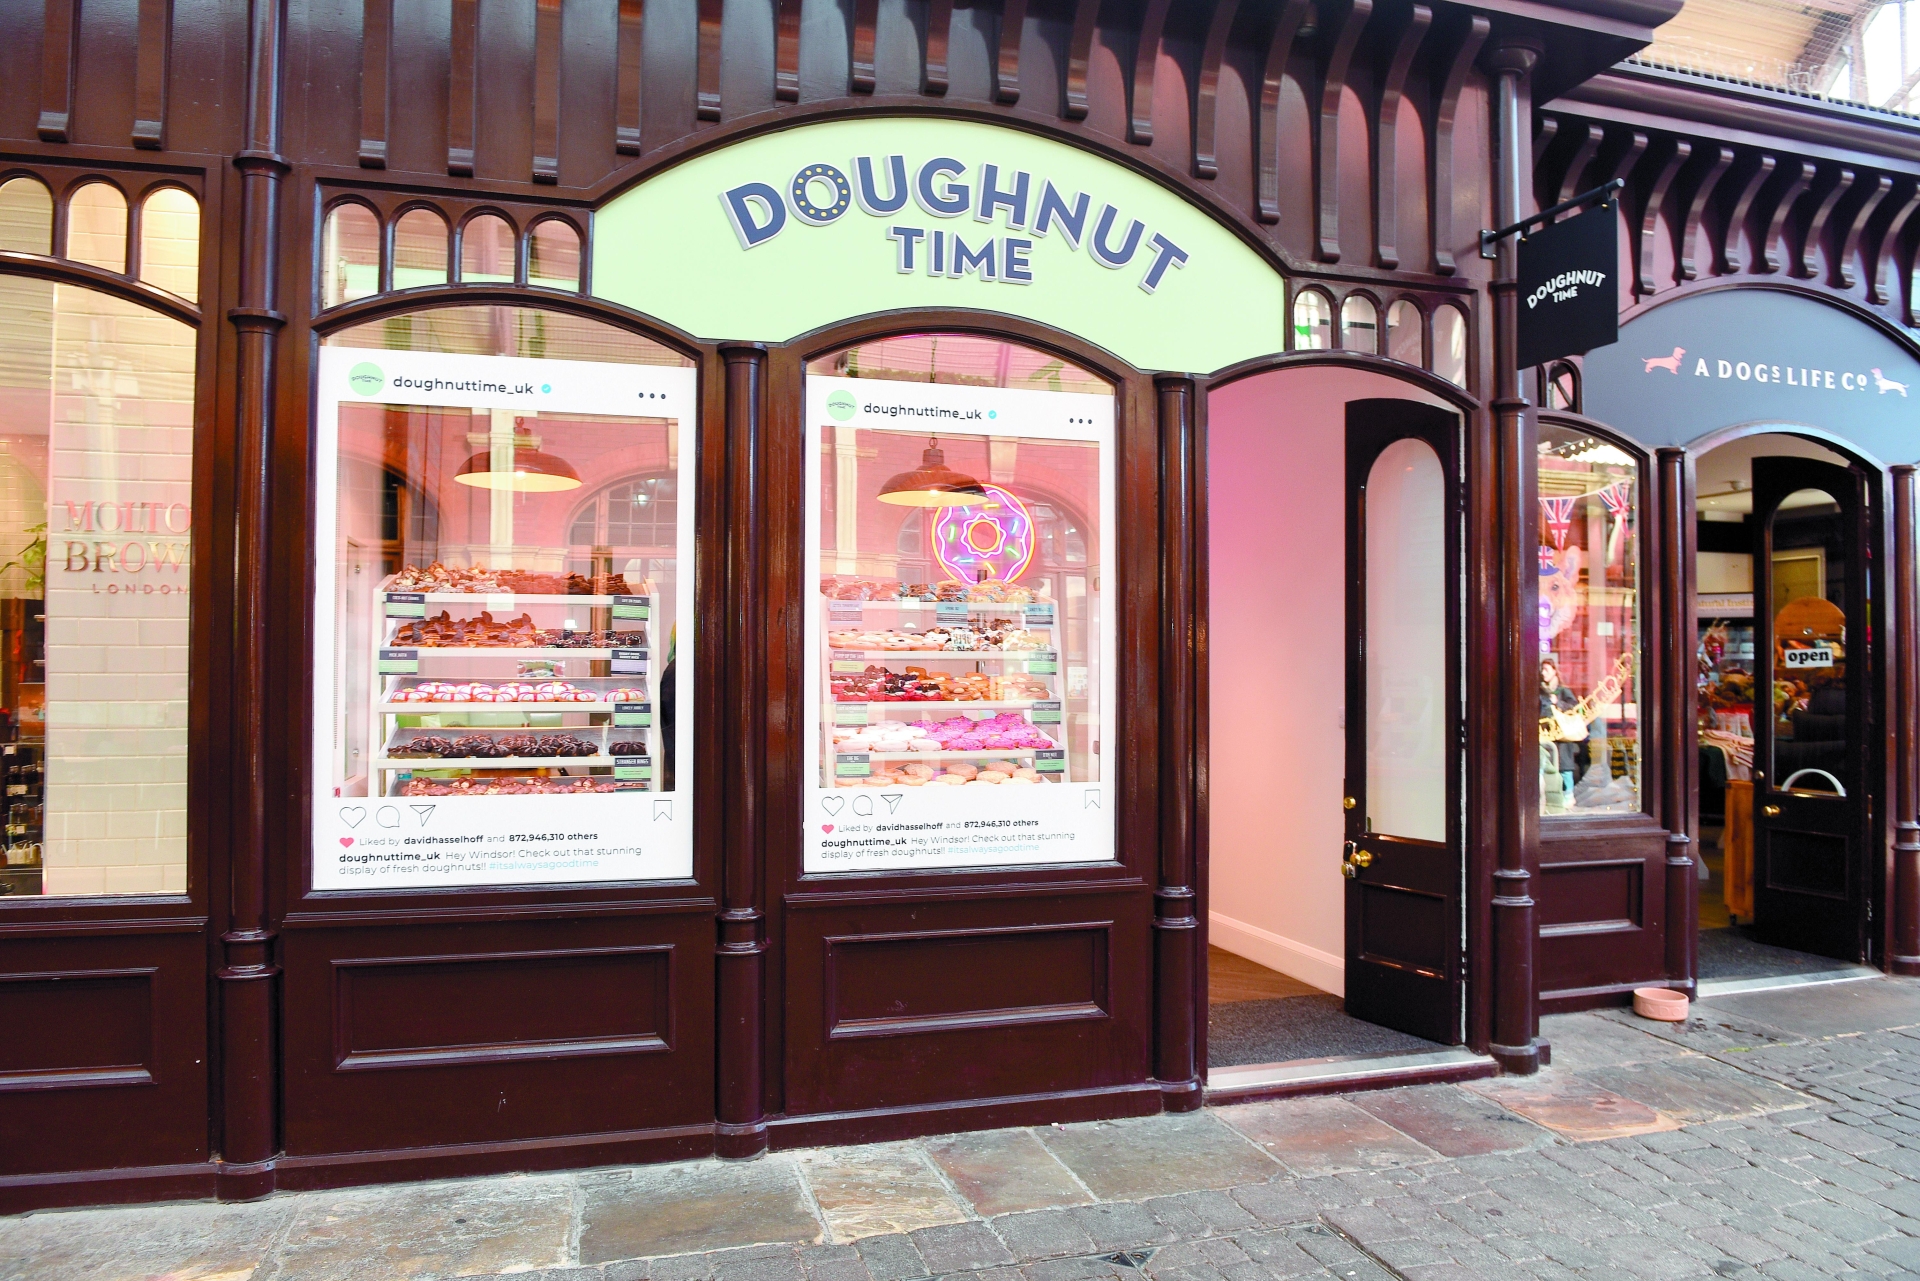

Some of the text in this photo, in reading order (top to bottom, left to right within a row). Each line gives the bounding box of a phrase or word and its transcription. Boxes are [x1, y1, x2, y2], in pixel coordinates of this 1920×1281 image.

[718, 155, 1191, 295] DOUGHNUT
[886, 225, 1034, 286] TIME
[1526, 269, 1606, 309] DOUGHNUT
[1552, 286, 1578, 303] TIME
[1694, 357, 1710, 377] A
[1787, 366, 1836, 389] LIFE
[393, 375, 534, 395] doughnuttime_uk
[864, 402, 982, 421] doughnuttime_uk
[92, 583, 188, 595] LONDON
[1788, 650, 1830, 665] open
[838, 818, 1039, 834] Liked by davidhasselhoff and 872,946,310 others
[359, 832, 599, 847] Liked by davidhasselhoff and 872,946,310 others
[821, 831, 1076, 849] doughnuttime_uk Hey Windsor! Check out that stunning
[338, 845, 642, 864] doughnuttime_uk Hey Windsor! Check out that stunning
[821, 848, 854, 860] display
[855, 847, 865, 858] of
[866, 847, 890, 858] fresh
[947, 842, 1040, 856] #itsalwaysagoodtime
[338, 864, 377, 876] display
[379, 863, 391, 874] of
[392, 862, 420, 873] fresh
[488, 858, 599, 871] #itsalwaysagoodtime
